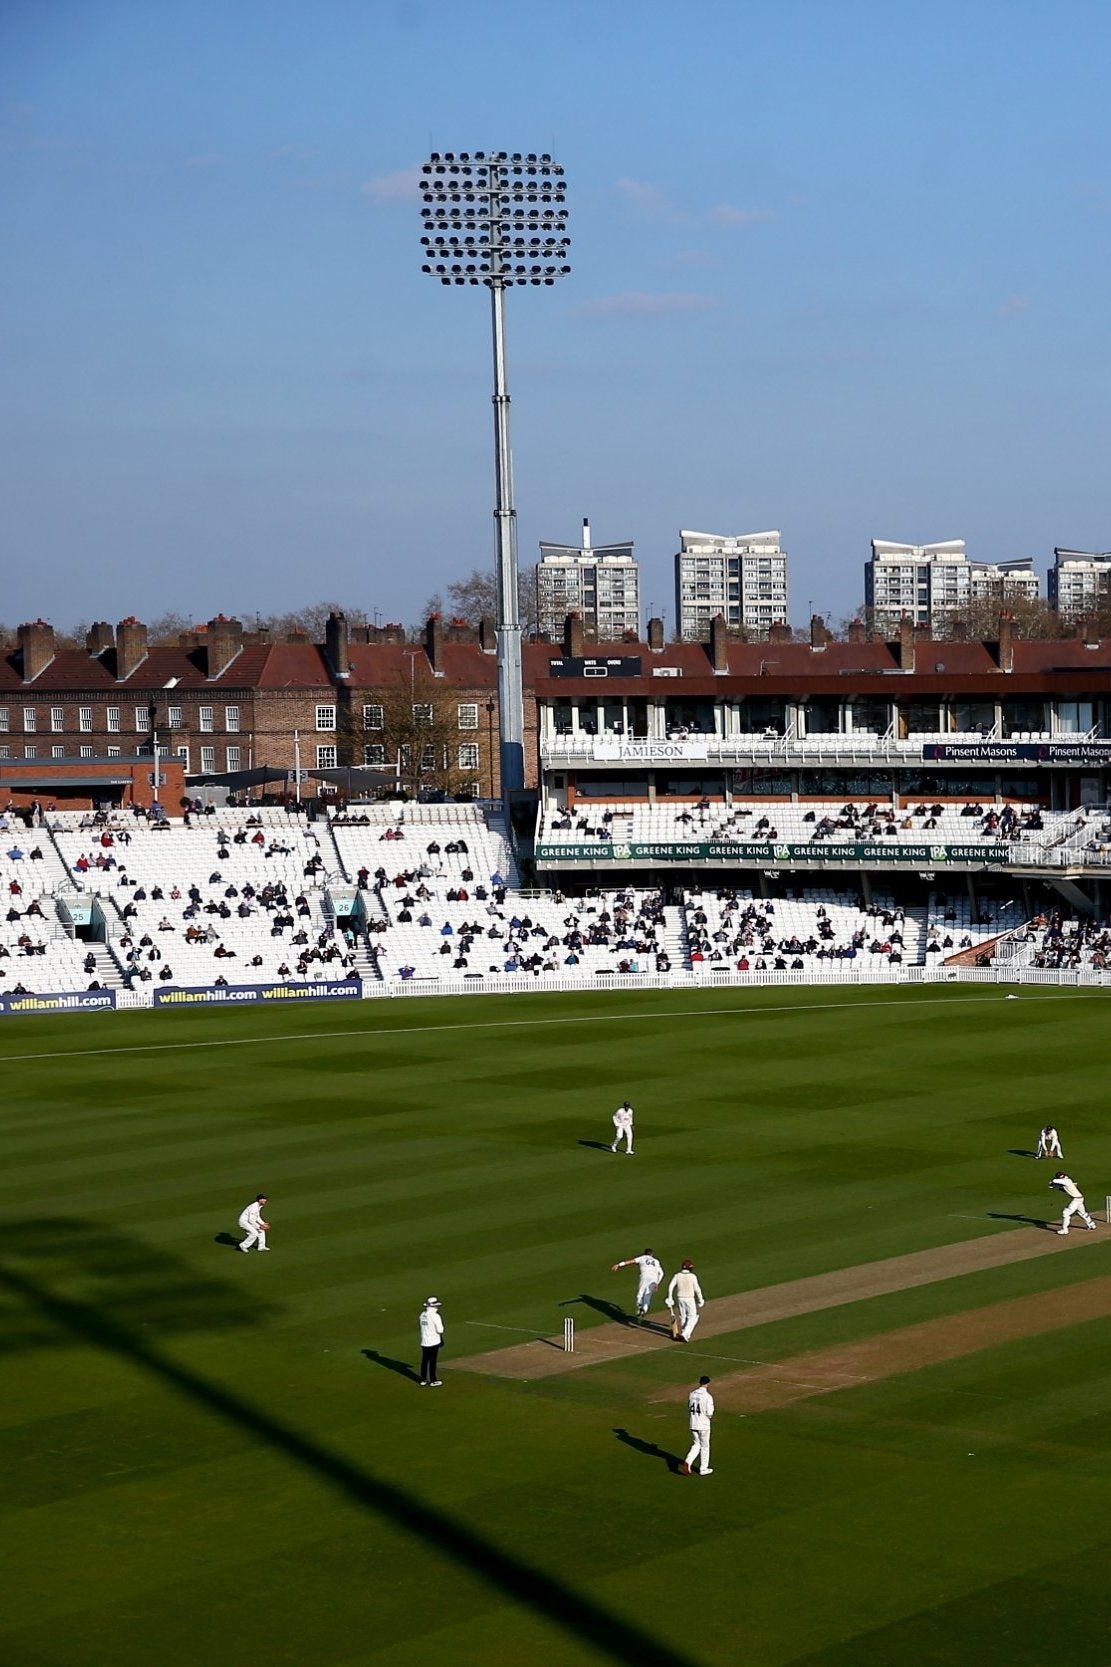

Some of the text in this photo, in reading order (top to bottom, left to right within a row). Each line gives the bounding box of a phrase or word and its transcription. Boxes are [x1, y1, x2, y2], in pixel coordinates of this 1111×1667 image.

[618, 746, 683, 756] JAMIESON
[945, 746, 1017, 756] Pinsent Masons
[1049, 746, 1080, 756] Pinsent
[541, 847, 609, 856] GREENE KING
[614, 845, 632, 857] IPA
[635, 846, 700, 855] GREENE KING
[709, 846, 769, 855] GREENE KING
[773, 845, 790, 857] IPA
[793, 847, 856, 856] GREENE KING
[864, 848, 926, 857] GREENE KING
[930, 846, 947, 858] IPA
[951, 848, 987, 857] GREENE
[339, 904, 350, 912] 26
[72, 913, 84, 921] 25
[159, 989, 257, 1003] williamhill.com
[261, 985, 358, 1000] williamhill.com
[9, 995, 111, 1011] williamhill.com
